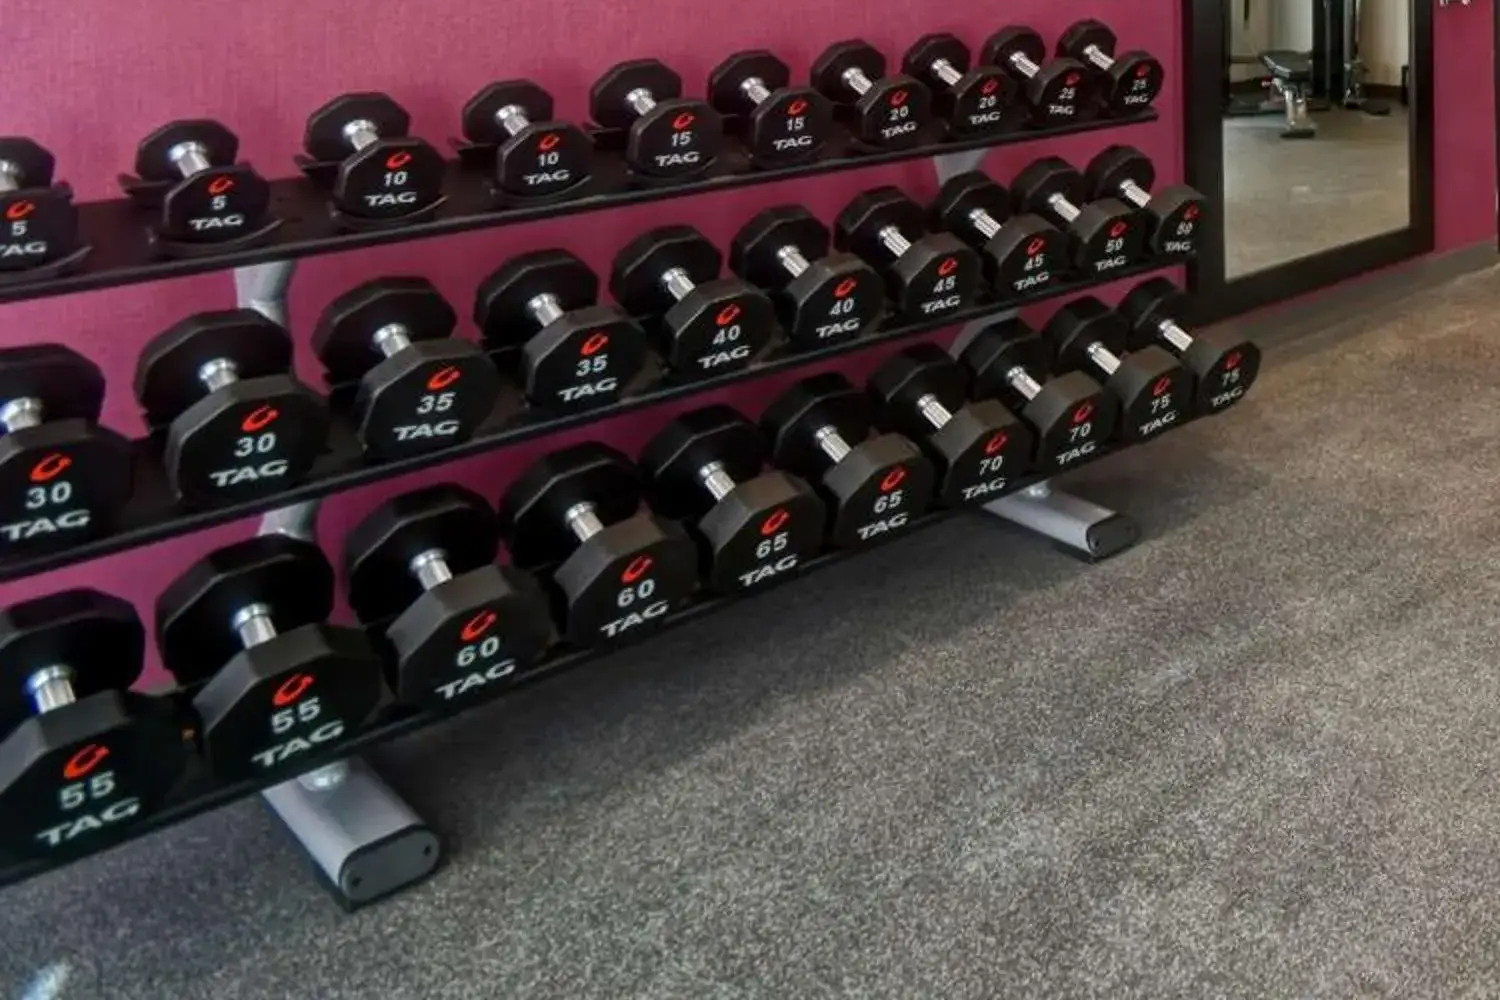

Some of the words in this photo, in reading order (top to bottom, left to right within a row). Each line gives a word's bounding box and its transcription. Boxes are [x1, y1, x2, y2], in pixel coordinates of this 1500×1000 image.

[786, 117, 804, 131] 15
[671, 132, 691, 147] 15
[773, 135, 812, 151] TAG
[538, 152, 559, 167] 10
[655, 151, 700, 167] TAG
[384, 171, 408, 187] 10
[524, 169, 570, 185] TAG
[211, 195, 227, 211] 5
[365, 191, 417, 207] TAG
[11, 221, 27, 237] 5
[190, 214, 244, 231] TAG
[1105, 238, 1124, 252] 50
[1023, 252, 1045, 272] 45
[1094, 255, 1126, 272] TAG
[933, 275, 956, 293] 45
[1013, 270, 1050, 292] TAG
[828, 297, 855, 316] 40
[920, 295, 961, 314] TAG
[712, 324, 742, 347] 40
[815, 317, 861, 339] TAG
[575, 353, 608, 378] 35
[697, 345, 752, 370] TAG
[557, 377, 619, 402] TAG
[416, 392, 456, 415] 35
[1150, 392, 1170, 414] 75
[393, 419, 460, 442] TAG
[1068, 422, 1092, 442] 70
[1138, 410, 1177, 436] TAG
[234, 432, 277, 459] 30
[1055, 440, 1097, 465] TAG
[210, 459, 289, 488] TAG
[979, 455, 1003, 476] 70
[25, 481, 72, 509] 30
[960, 477, 1007, 500] TAG
[873, 489, 904, 514] 65
[1, 508, 91, 541] TAG
[856, 511, 909, 541] TAG
[755, 531, 788, 560] 65
[738, 553, 799, 588] TAG
[616, 578, 655, 607] 60
[600, 600, 670, 638] TAG
[456, 636, 500, 667] 60
[435, 658, 517, 700] TAG
[270, 696, 321, 735] 55
[250, 720, 345, 768] TAG
[60, 769, 117, 811] 55
[36, 797, 141, 847] TAG
